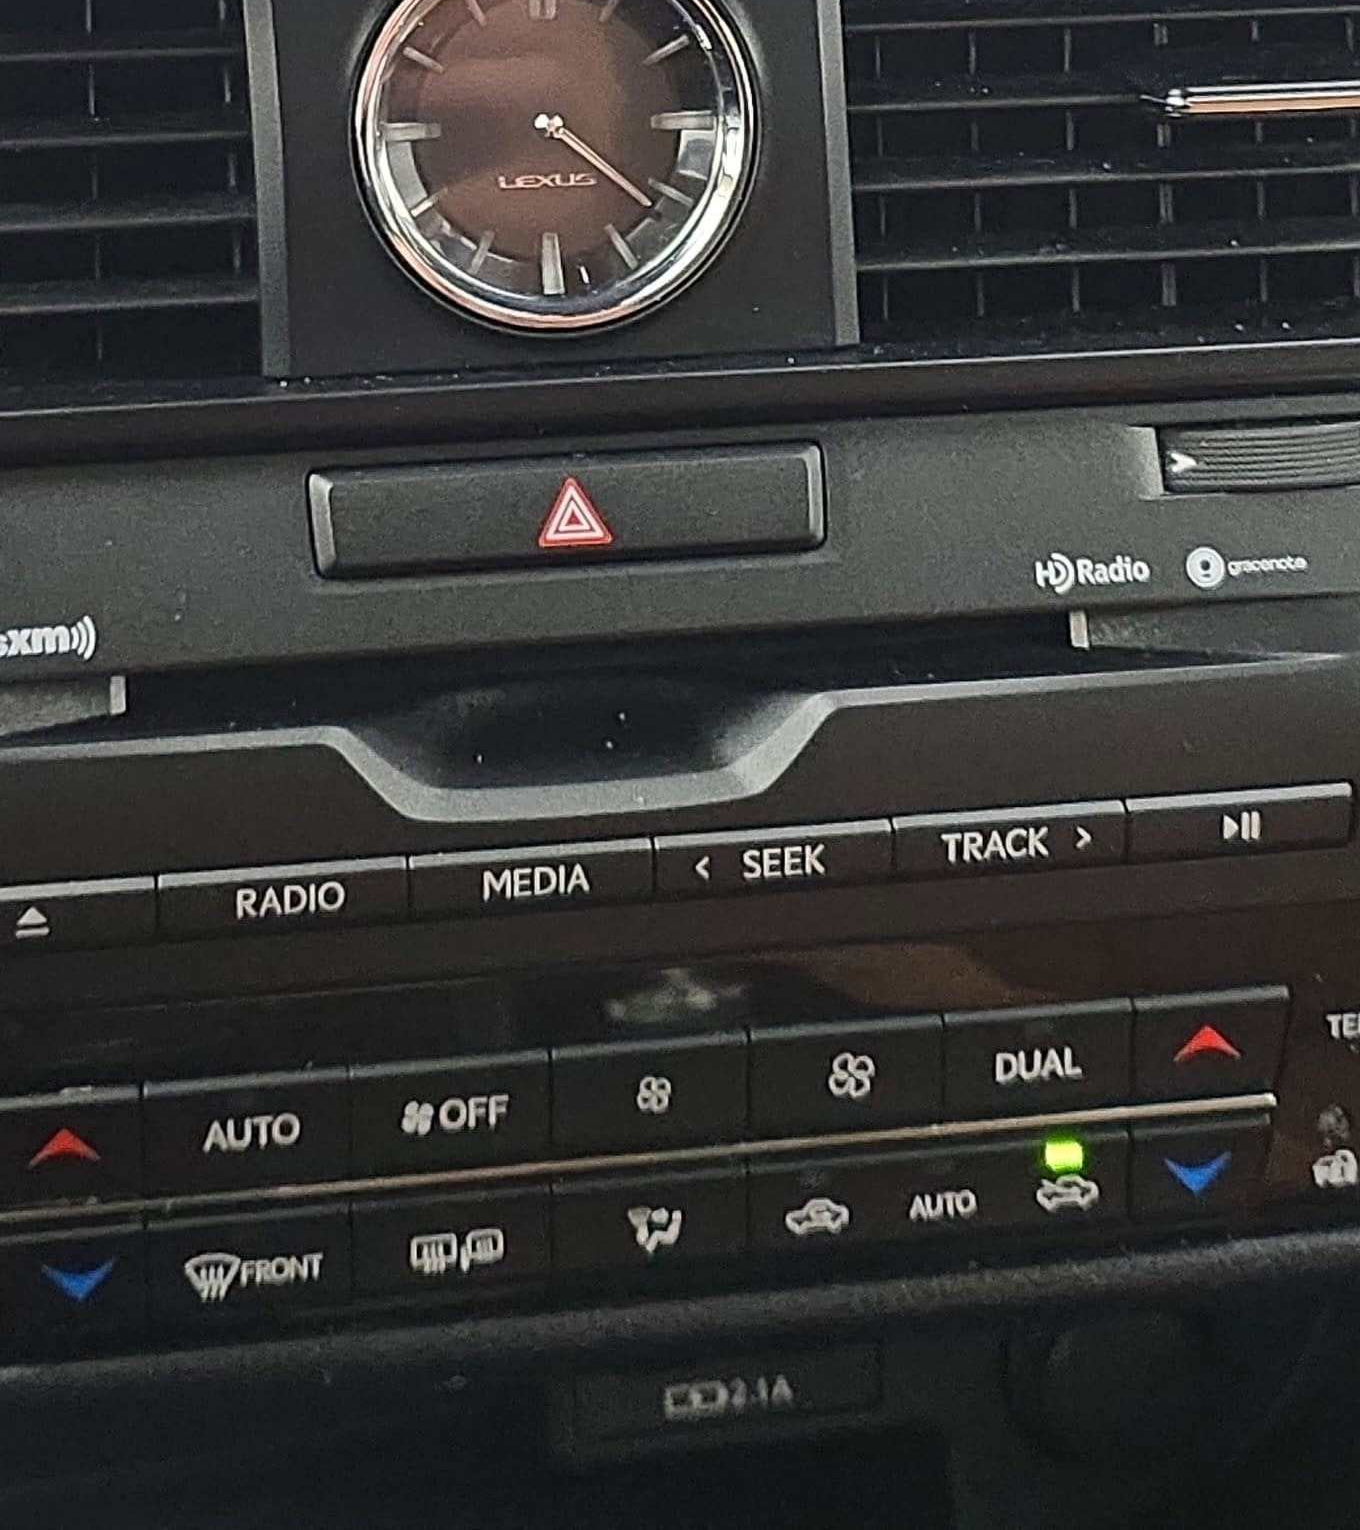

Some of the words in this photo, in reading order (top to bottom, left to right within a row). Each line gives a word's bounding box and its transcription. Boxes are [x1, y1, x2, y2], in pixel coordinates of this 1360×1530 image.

[498, 172, 597, 189] LEXUS
[1077, 555, 1150, 585] Radio
[742, 844, 826, 881] SEEK
[942, 826, 1050, 864] TRACK
[236, 881, 346, 919] RADIO
[482, 863, 591, 903] MEDIA
[994, 1046, 1083, 1085] DUAL
[439, 1094, 509, 1132] OFF
[203, 1112, 301, 1154] AUTO
[908, 1190, 978, 1222] AUTO
[240, 1252, 324, 1286] FRONT
